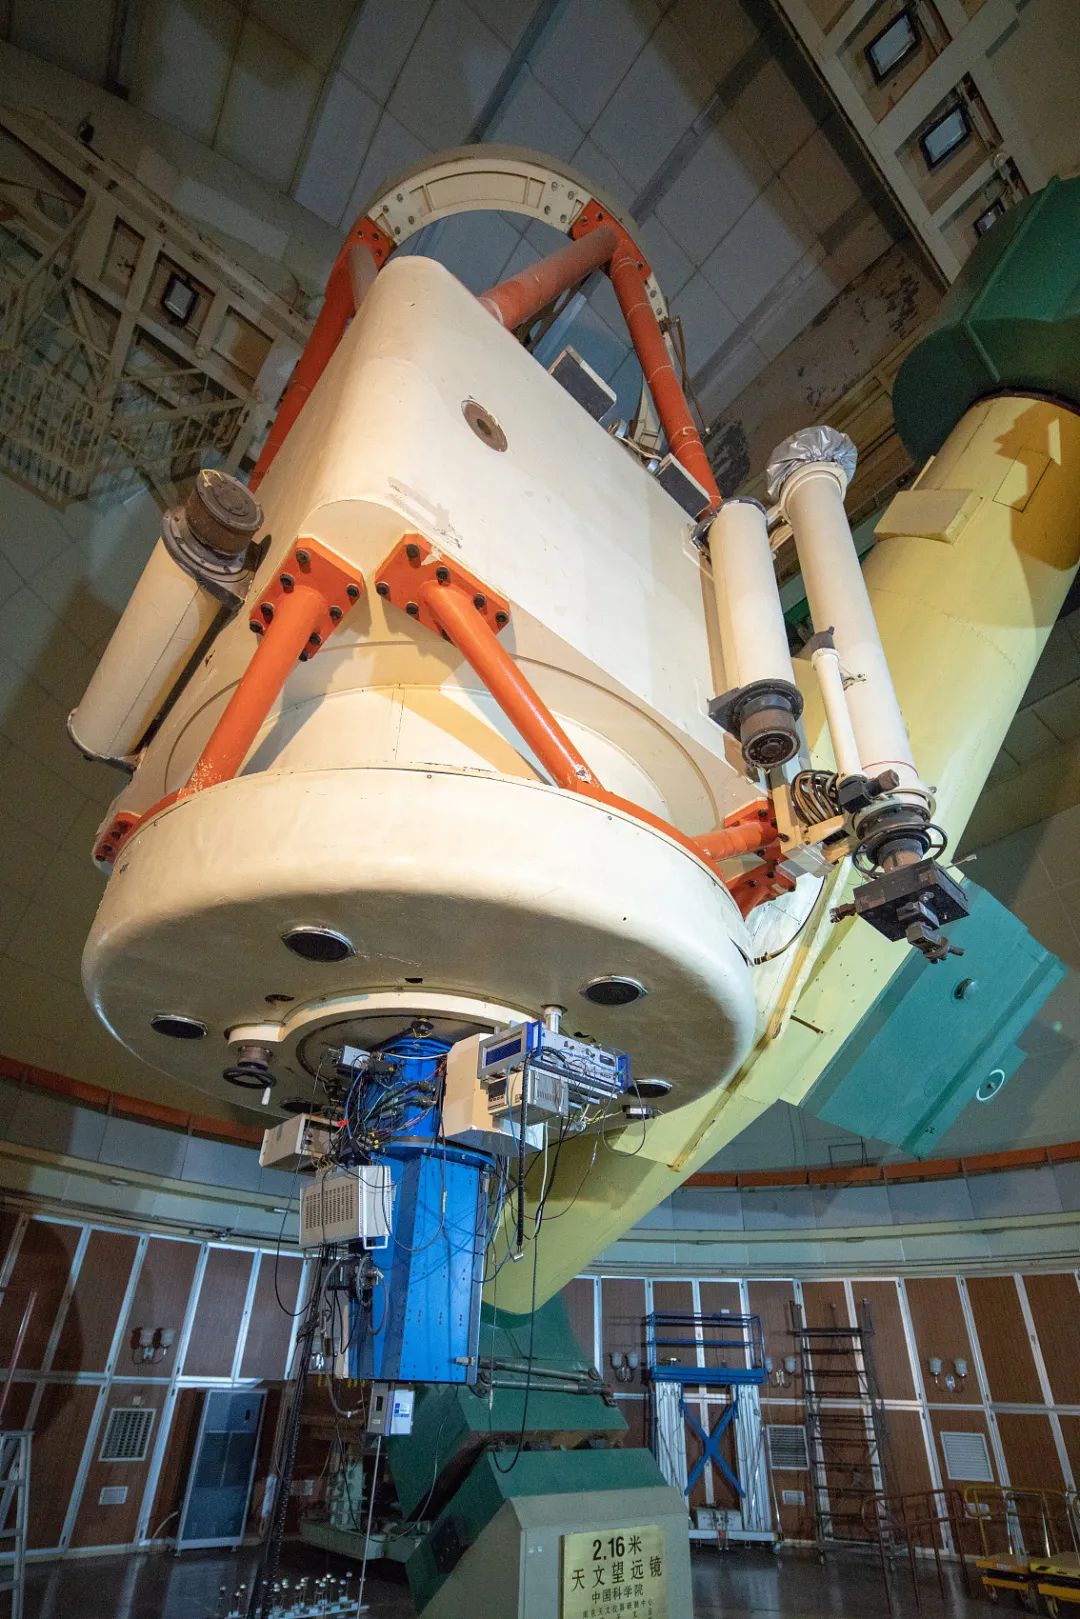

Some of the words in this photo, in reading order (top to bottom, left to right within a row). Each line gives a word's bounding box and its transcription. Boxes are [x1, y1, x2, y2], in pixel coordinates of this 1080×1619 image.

[592, 1535, 642, 1561] 2.16米
[571, 1555, 662, 1592] 天文望远镜
[591, 1583, 644, 1605] 中国科学院
